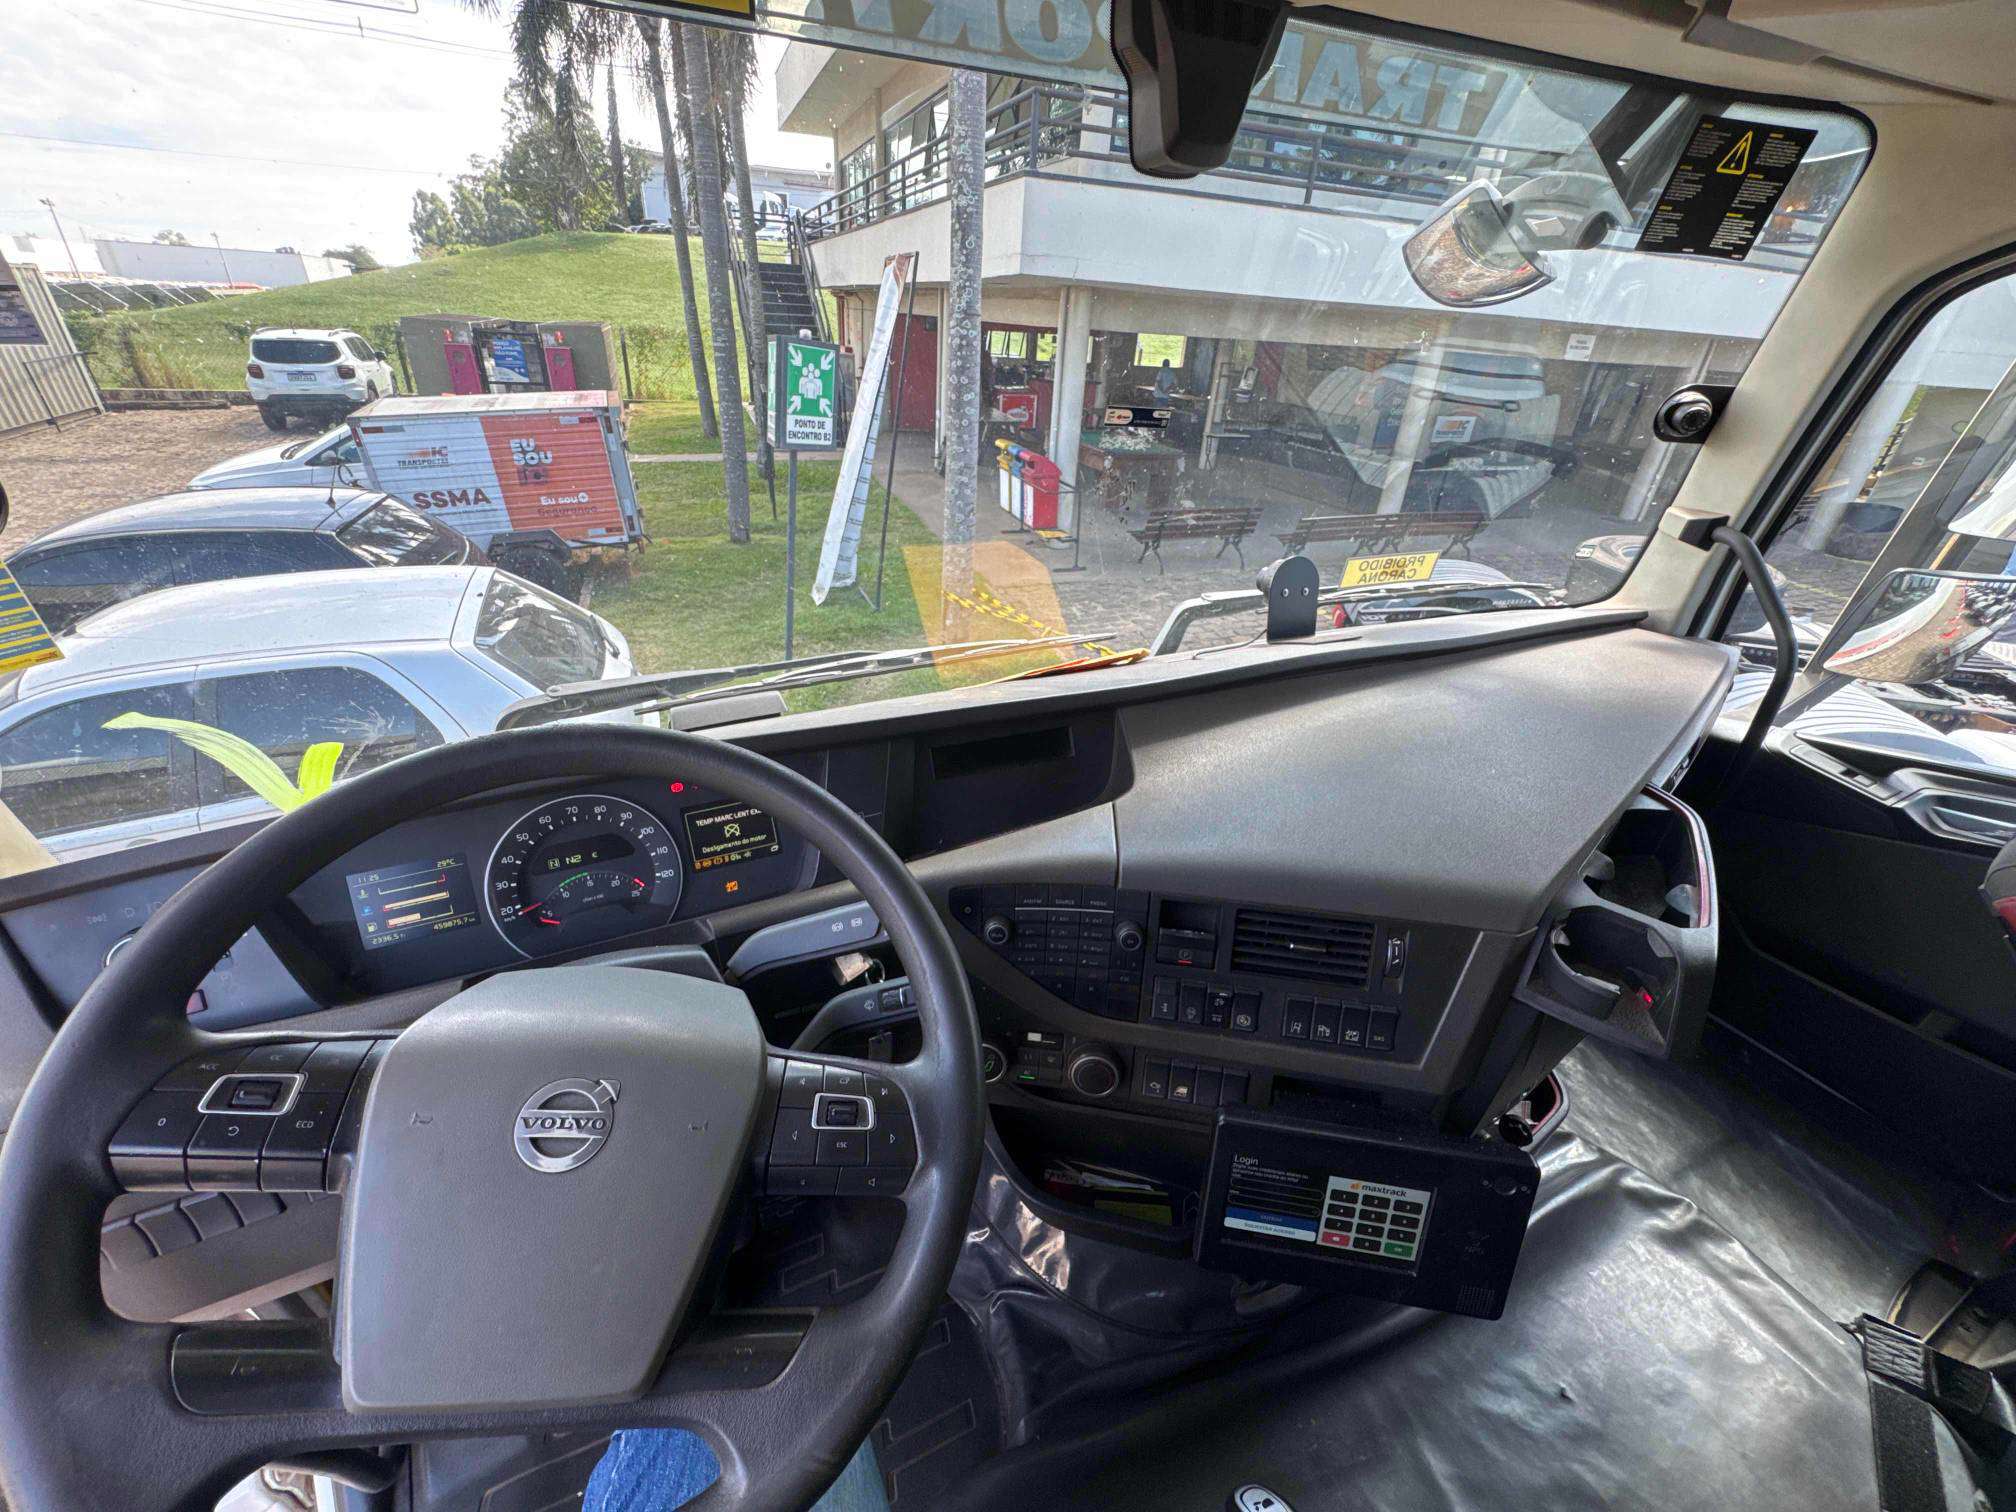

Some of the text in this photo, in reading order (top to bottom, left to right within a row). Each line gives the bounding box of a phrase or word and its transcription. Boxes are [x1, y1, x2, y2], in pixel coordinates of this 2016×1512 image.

[794, 418, 826, 430] PONTO DE
[788, 430, 832, 442] ENCONTRO B2
[510, 438, 536, 453] EU
[513, 450, 553, 466] SOU
[413, 488, 492, 510] SSMA
[540, 496, 556, 506] Eu
[566, 806, 578, 814] 70
[594, 805, 607, 813] 80
[539, 816, 552, 824] 60
[620, 812, 633, 820] 90
[696, 818, 714, 827] TEMP
[714, 813, 733, 823] MARC
[734, 810, 749, 818] LENT
[640, 826, 654, 835] 100
[516, 832, 530, 842] 50
[702, 840, 741, 854] Desligamento
[750, 834, 767, 843] motor
[656, 846, 668, 854] 110
[501, 856, 514, 864] 40
[566, 855, 582, 864] N2
[661, 870, 674, 878] 120
[496, 881, 509, 891] 30
[500, 906, 513, 916] 20
[296, 1120, 314, 1129] ECO
[520, 1116, 607, 1130] VOLVO
[1234, 1153, 1259, 1165] Login
[1362, 1184, 1407, 1197] maxtrack
